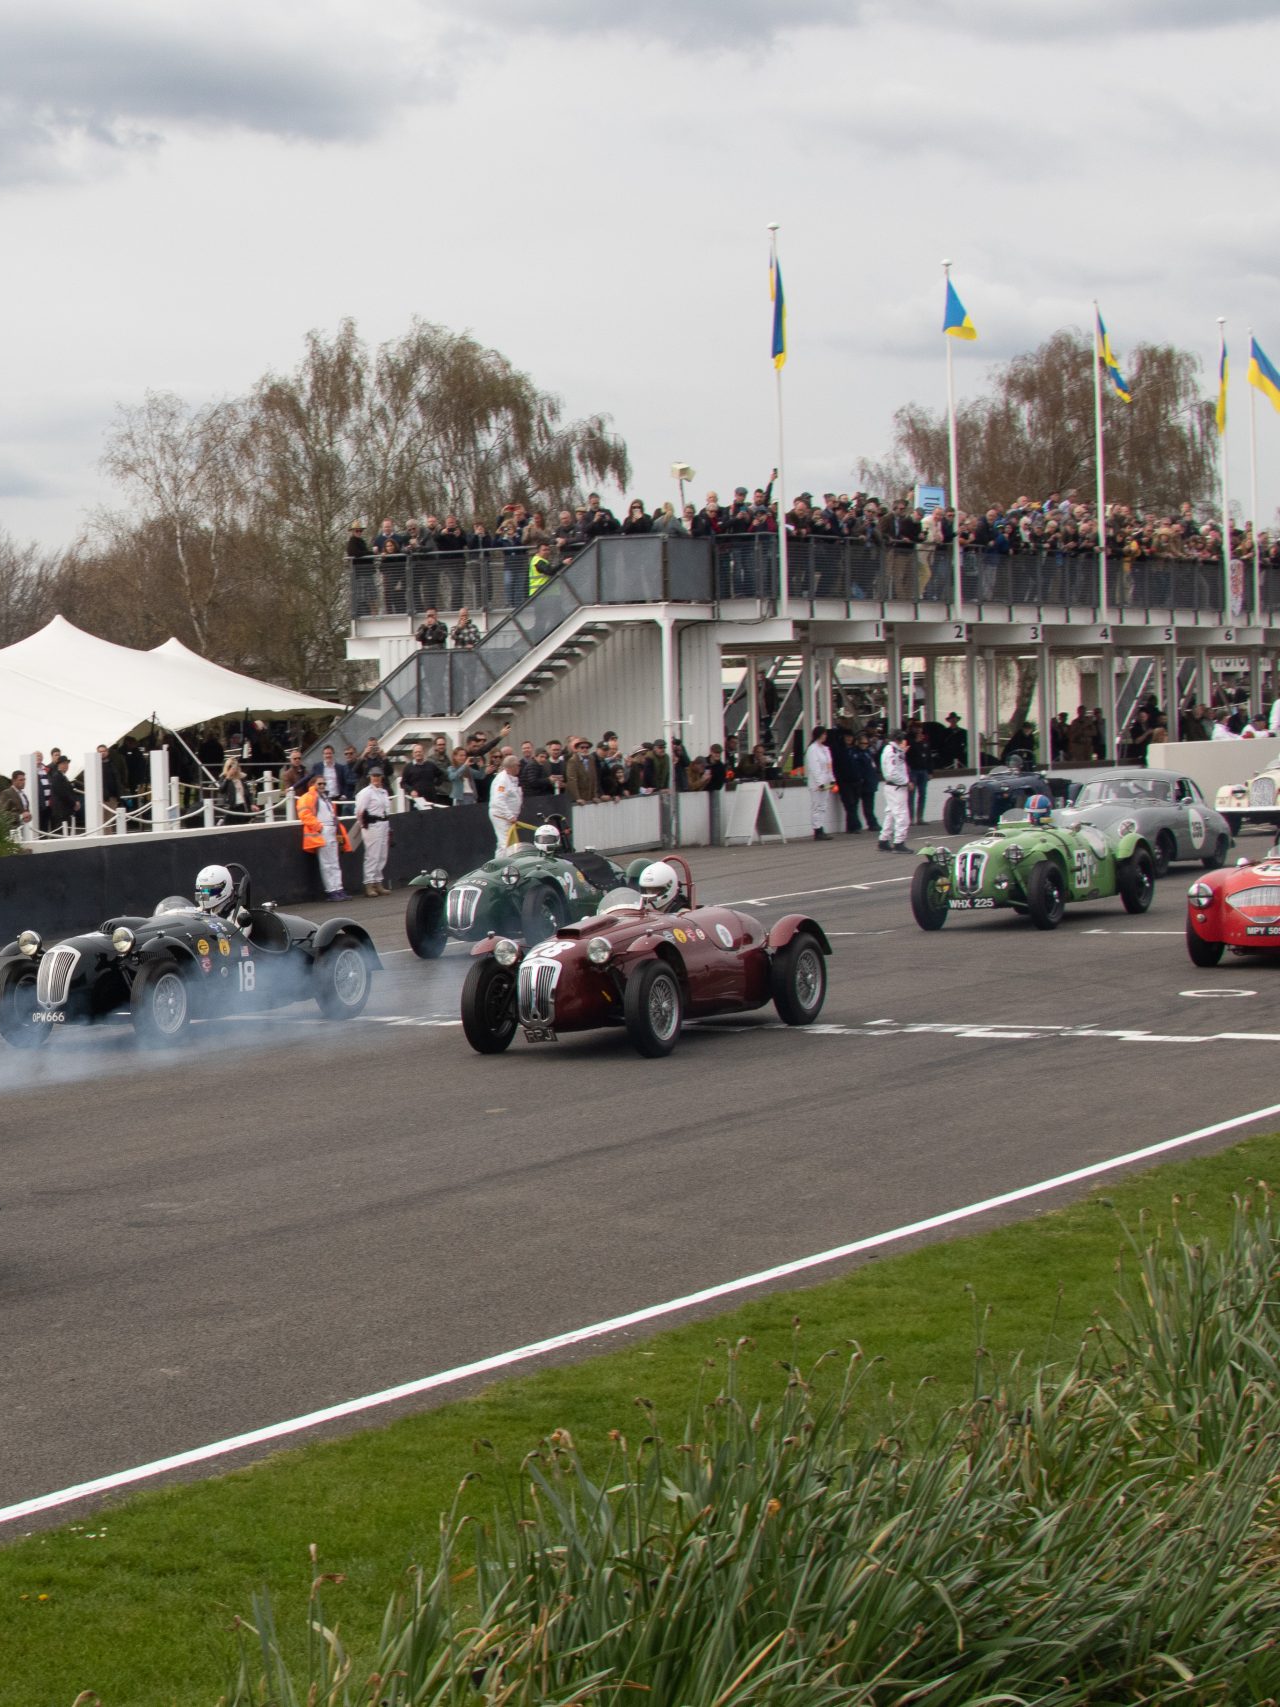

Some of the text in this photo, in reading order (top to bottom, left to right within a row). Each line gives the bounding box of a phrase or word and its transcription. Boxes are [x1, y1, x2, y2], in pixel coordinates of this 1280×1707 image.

[954, 625, 963, 638] 2
[1030, 626, 1039, 639] 3
[1100, 627, 1109, 640] 4
[1164, 628, 1173, 641] 5
[1224, 629, 1233, 641] 6
[948, 898, 994, 909] WHX 225
[1247, 926, 1265, 935] MPY
[238, 960, 256, 992] 18
